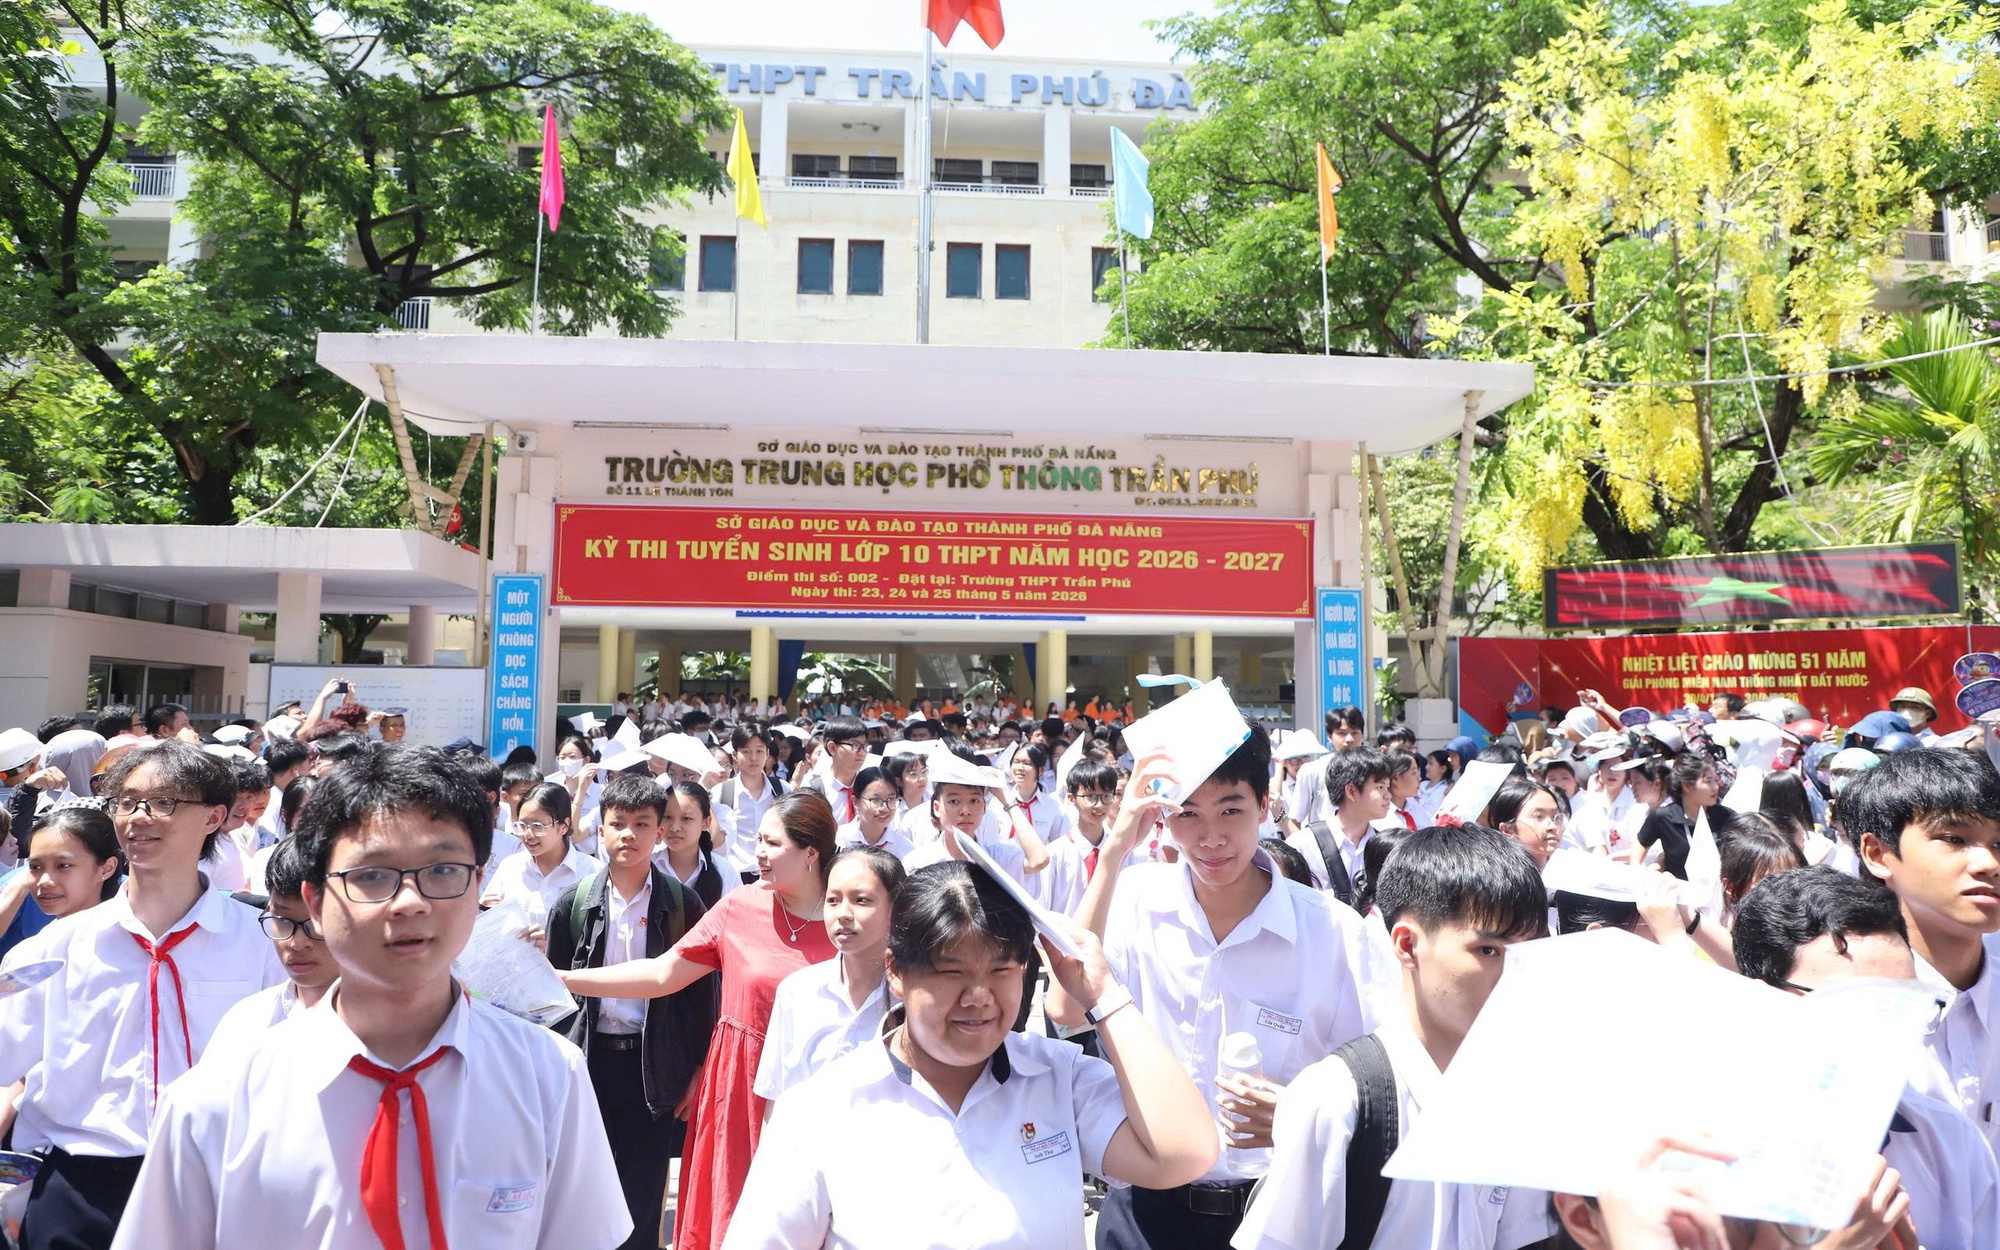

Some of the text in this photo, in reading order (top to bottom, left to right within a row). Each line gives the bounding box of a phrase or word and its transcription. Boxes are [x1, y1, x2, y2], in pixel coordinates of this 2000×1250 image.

[848, 58, 986, 102] TRẦN
[1011, 70, 1110, 107] PHÚ
[1132, 73, 1199, 111] ĐÀ
[785, 440, 822, 454] GIÁO
[827, 443, 858, 456] DỤC
[887, 442, 918, 456] ĐÀO
[923, 445, 951, 459] TẠO
[956, 444, 1006, 458] THÀNH
[1049, 446, 1069, 459] ĐÀ
[605, 449, 734, 484] TRƯỜNG
[741, 459, 845, 486] TRUNG
[853, 461, 918, 494] HỌC
[998, 459, 1103, 491] THÔNG
[1197, 462, 1259, 494] PHÚ
[626, 486, 642, 495] 11
[715, 514, 742, 530] SỞ
[748, 516, 794, 530] GIÁO
[800, 519, 839, 533] DỤC
[845, 517, 871, 532] VÀ
[876, 518, 916, 533] ĐÀO
[921, 520, 959, 535] TẠO
[964, 520, 1028, 535] THÀNH
[1033, 520, 1072, 535] PHỐ
[1078, 523, 1104, 537] ĐÀ
[585, 535, 619, 558] KỲ
[627, 540, 667, 559] THI
[676, 534, 760, 561] TUYỂN
[768, 541, 832, 562] SINH
[840, 540, 890, 563] LỚP
[899, 545, 930, 563] 10
[938, 545, 1002, 565] THPT
[1009, 543, 1070, 567] NĂM
[1078, 548, 1129, 571] HỌC
[1137, 549, 1199, 570] 2026
[1224, 551, 1285, 571] 2027
[746, 570, 789, 582] Điểm
[793, 571, 815, 583] thi
[819, 571, 844, 583] số:
[848, 573, 878, 583] 002
[899, 573, 926, 586] Đặt
[930, 574, 957, 587] tại:
[961, 574, 1015, 587] Trường
[1019, 575, 1059, 587] THPT
[1063, 576, 1097, 588] Trần
[1101, 577, 1132, 589] Phú
[507, 589, 530, 608] MỘT
[791, 586, 1088, 601] Ngày thi: 23, 24 và 25 tháng 5 năm 2026
[501, 610, 533, 626] NGƯỜI
[499, 631, 534, 647] KHÔNG
[505, 654, 526, 670] ĐỌC
[1622, 648, 1867, 675] NHIỆT LIỆT CHÀO MỪNG 51 NĂM
[501, 673, 528, 689] SÁCH
[1711, 676, 1737, 688] NAM
[1739, 672, 1776, 688] THỐNG
[502, 712, 524, 730] HƠN
